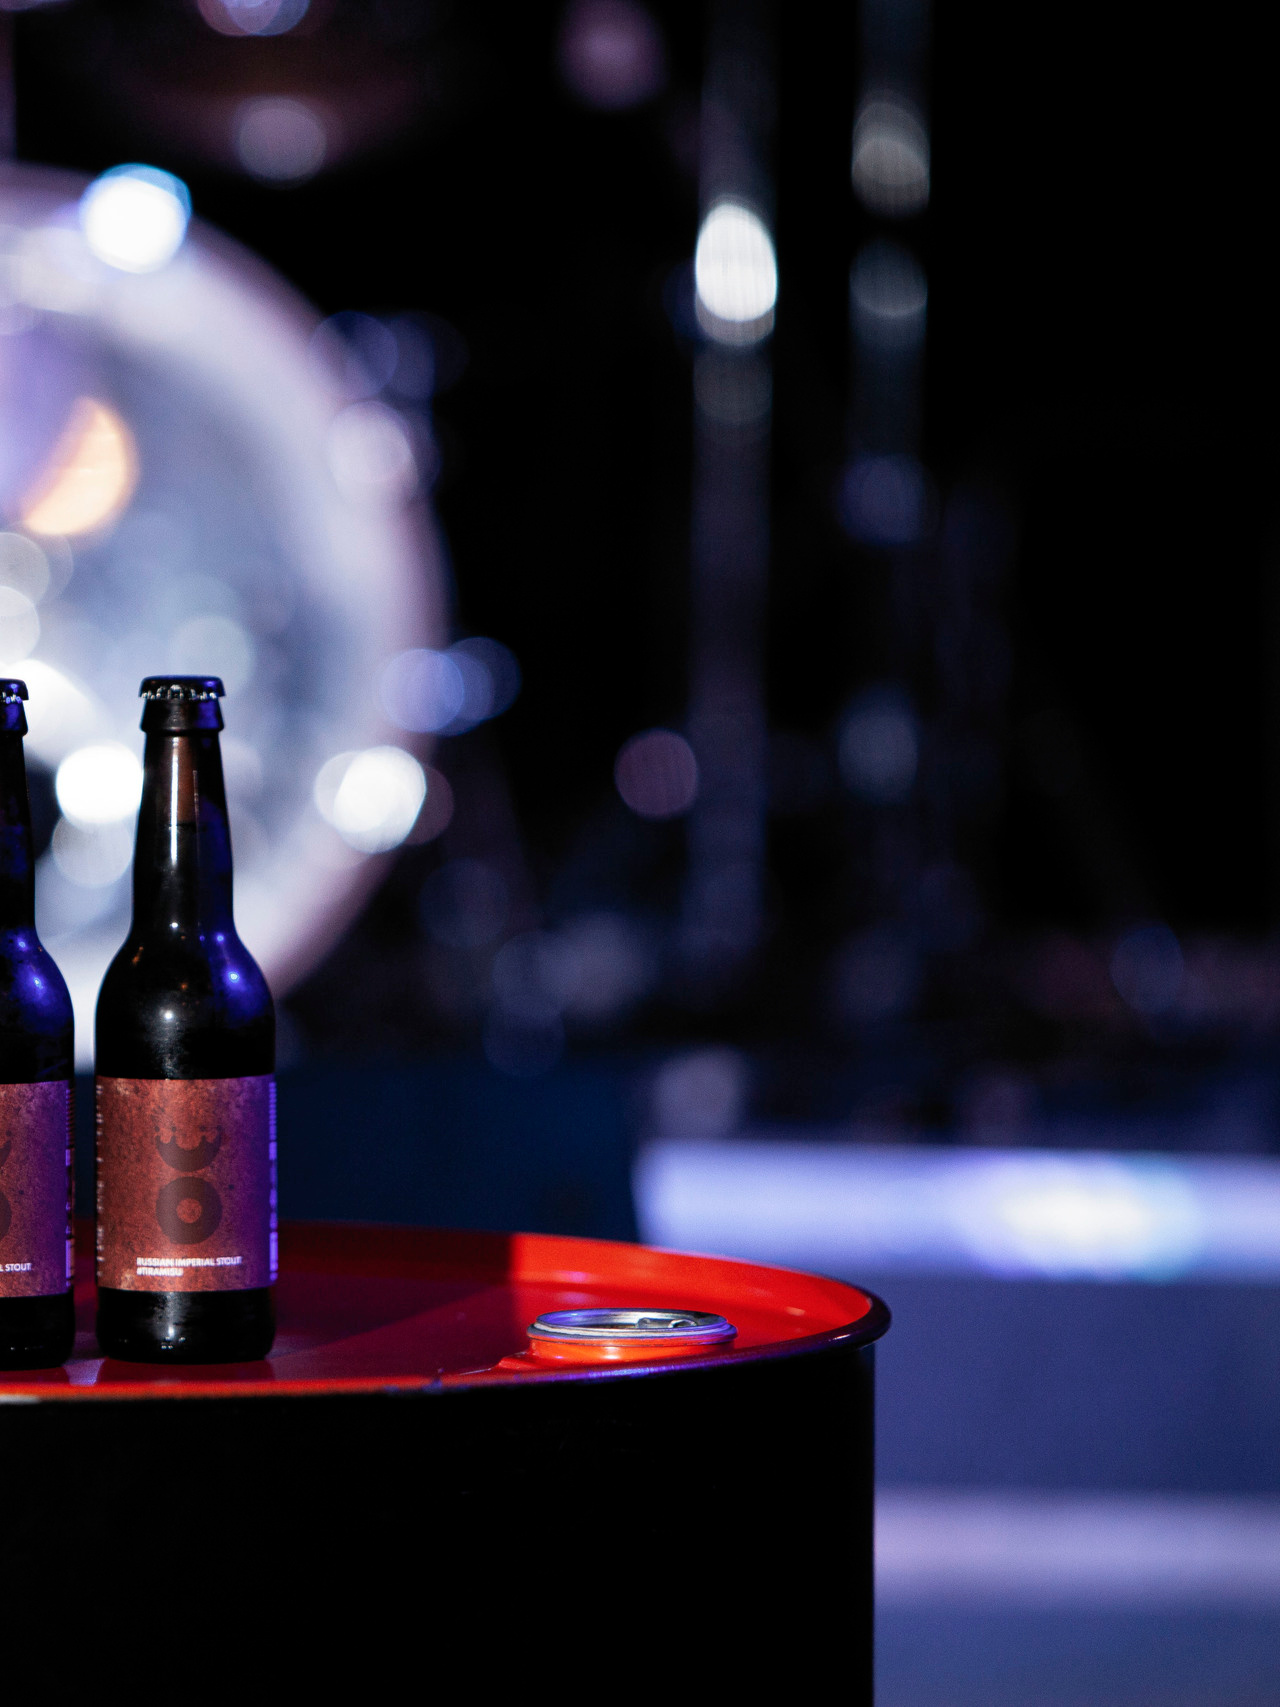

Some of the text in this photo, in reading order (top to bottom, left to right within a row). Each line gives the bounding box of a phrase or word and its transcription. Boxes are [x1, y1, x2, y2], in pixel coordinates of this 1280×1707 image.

[136, 1256, 242, 1267] RUSSIAN IMPERIAL STOUT
[5, 1263, 32, 1272] STOUT
